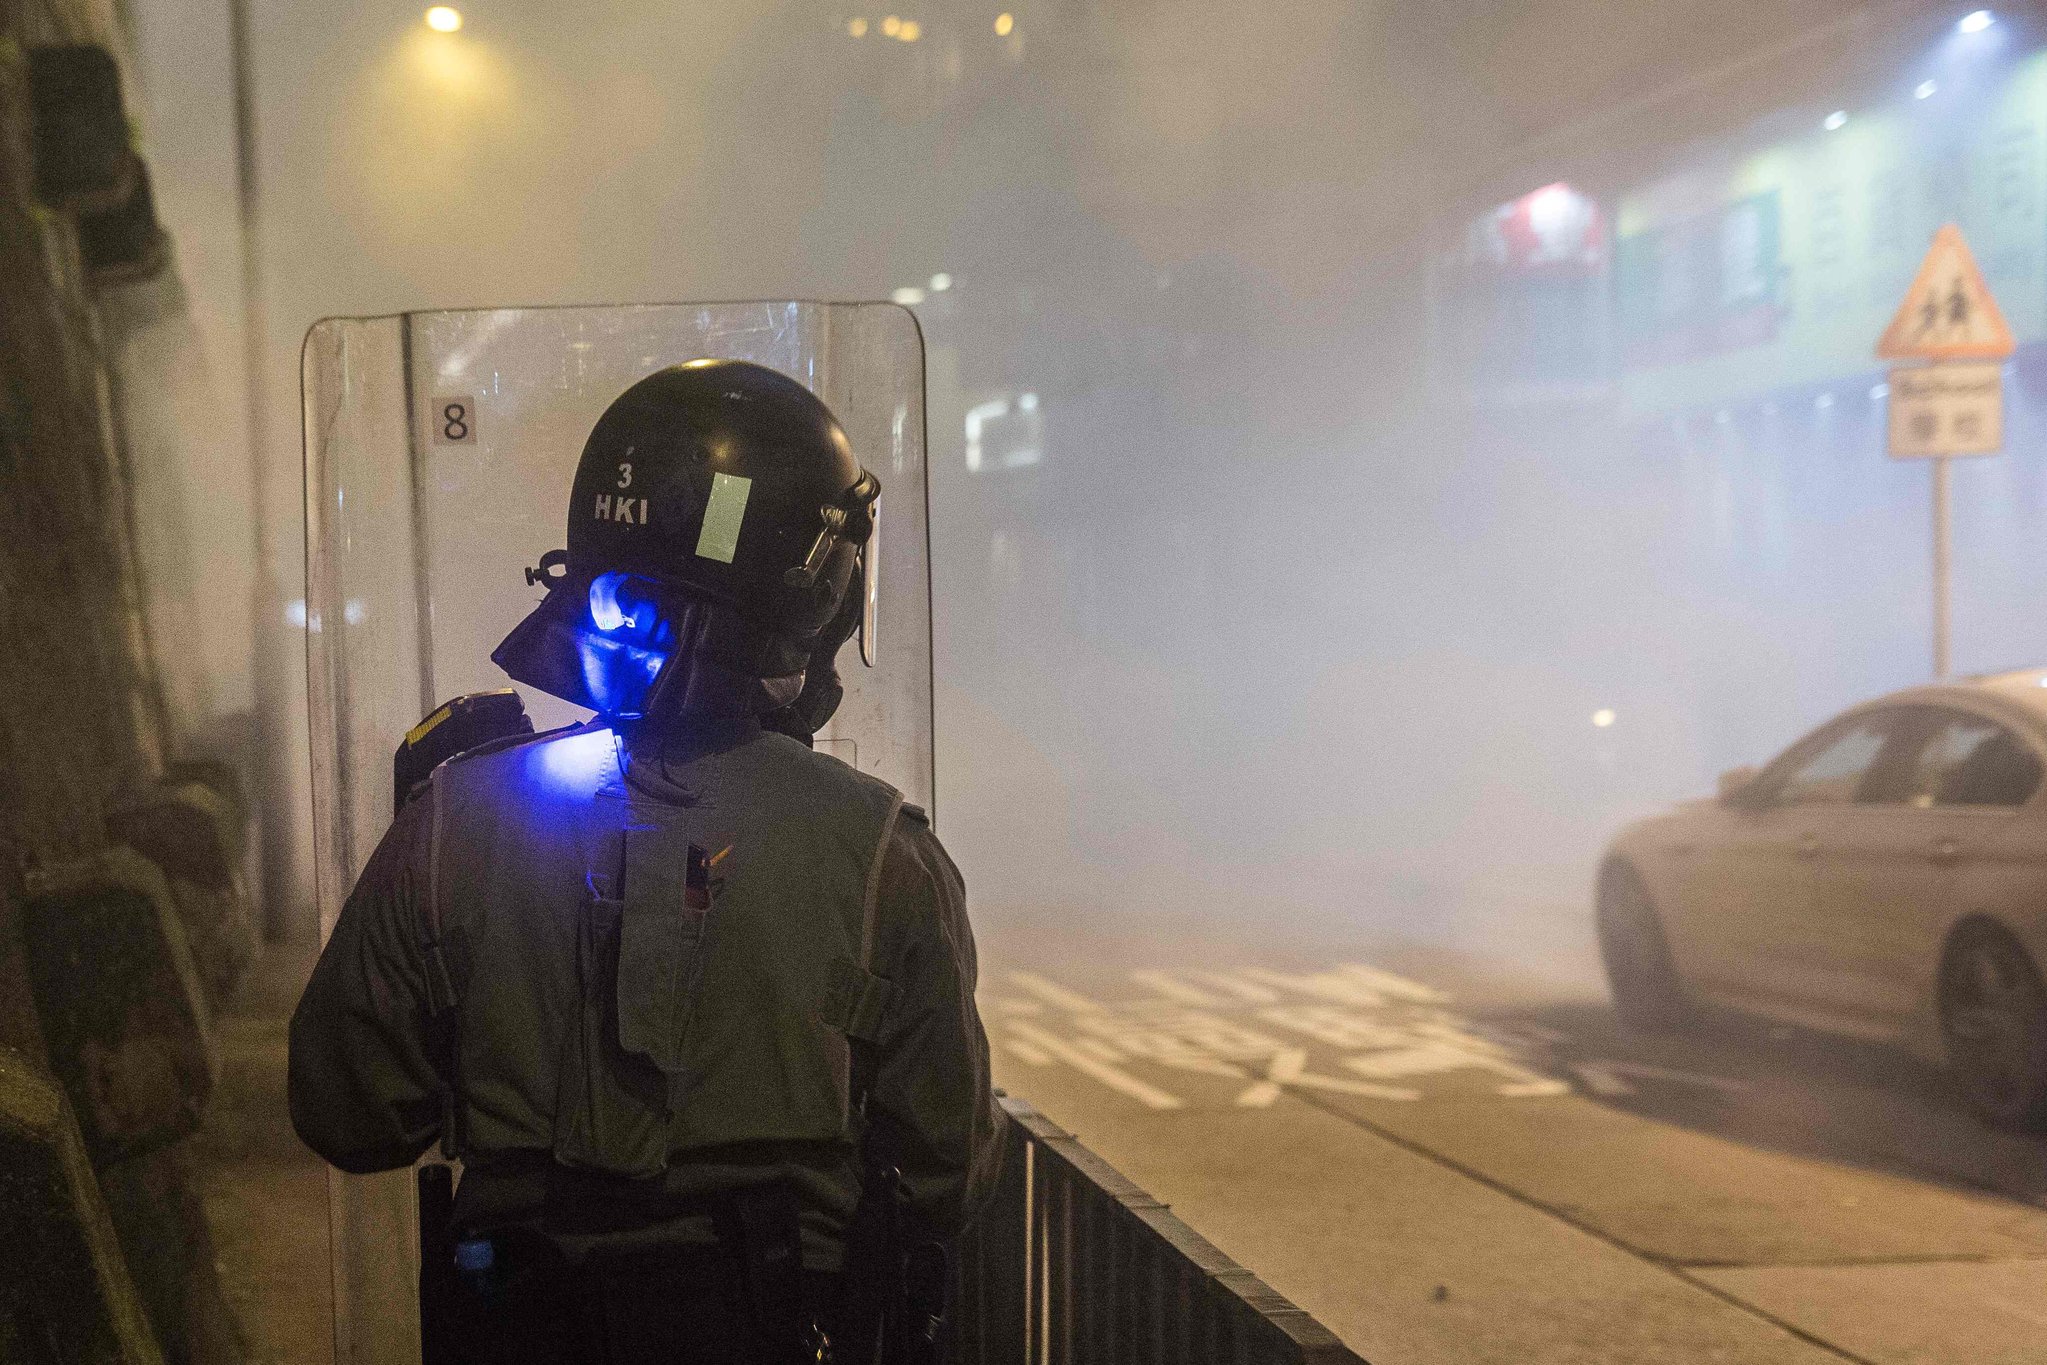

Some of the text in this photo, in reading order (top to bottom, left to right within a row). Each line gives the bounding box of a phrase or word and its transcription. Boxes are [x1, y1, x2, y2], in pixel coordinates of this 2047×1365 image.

[444, 404, 468, 440] 8
[617, 463, 632, 489] 3
[594, 494, 648, 525] HKI
